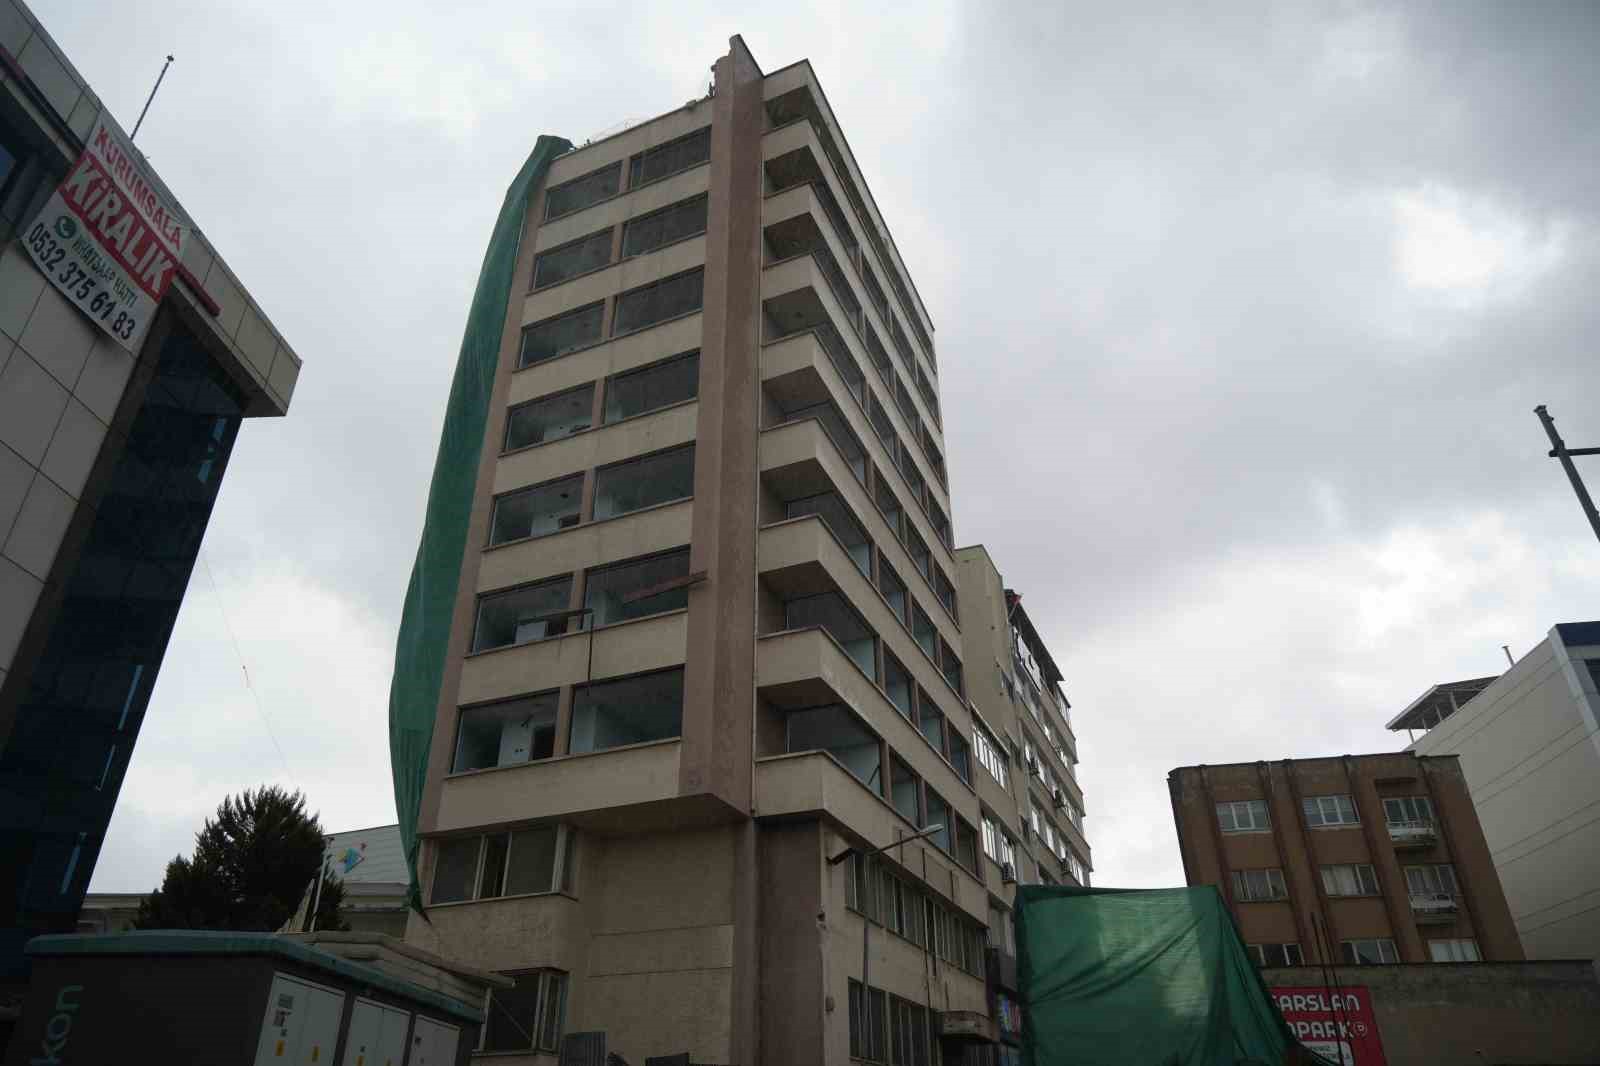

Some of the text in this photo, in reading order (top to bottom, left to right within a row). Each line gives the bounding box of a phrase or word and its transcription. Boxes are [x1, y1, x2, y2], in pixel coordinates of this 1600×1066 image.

[28, 223, 136, 340] 0532 375 61 83
[66, 162, 176, 295] KİRALIK
[1272, 994, 1360, 1012] ARSLAN
